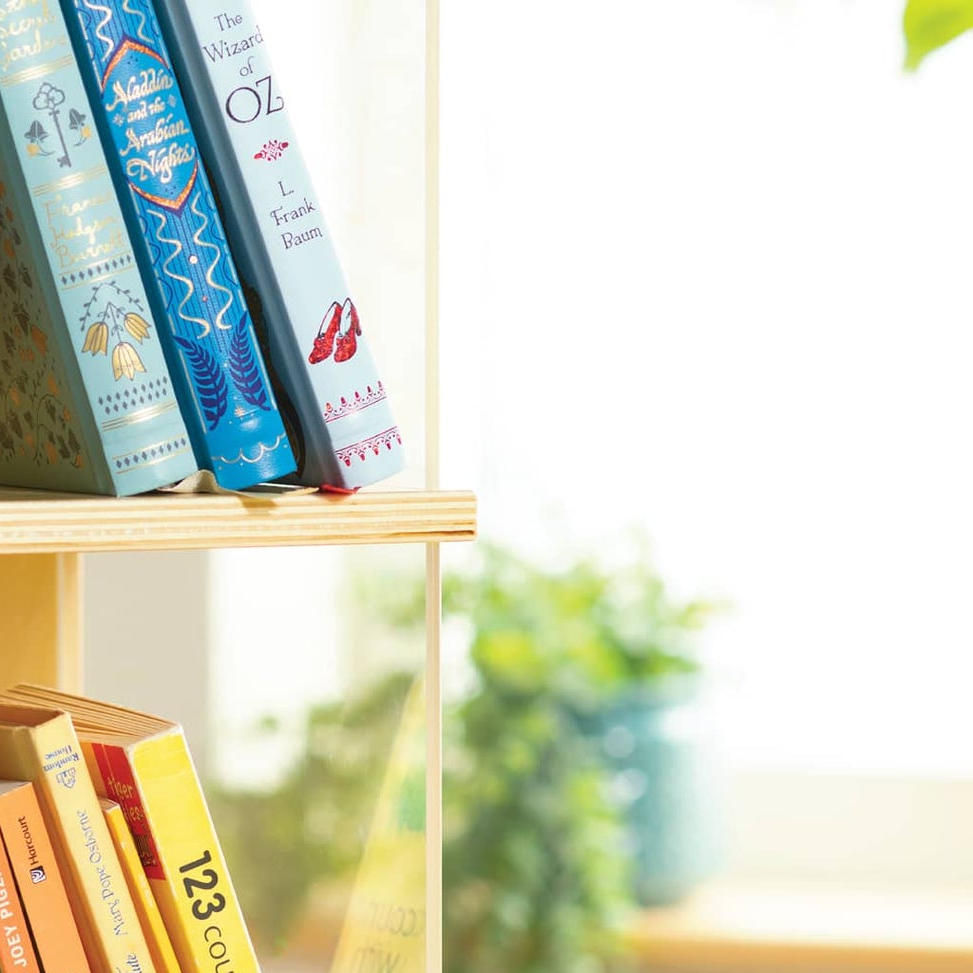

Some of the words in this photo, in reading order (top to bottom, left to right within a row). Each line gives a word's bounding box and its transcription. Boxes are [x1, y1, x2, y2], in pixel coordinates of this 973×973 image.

[214, 12, 243, 32] The
[202, 25, 265, 63] Wizard
[239, 55, 255, 77] of
[105, 68, 174, 112] Aladdin
[128, 107, 148, 123] and
[148, 97, 166, 114] the
[120, 113, 190, 157] Arabian
[126, 142, 196, 184] Nights
[278, 180, 295, 197] L.
[269, 197, 317, 227] Frank
[281, 226, 324, 250] Baum
[43, 752, 80, 772] Random
[45, 745, 72, 760] House
[18, 815, 39, 866] Harcourt
[77, 809, 102, 864] Osborne
[96, 865, 114, 901] Pope
[179, 850, 226, 921] 123
[108, 899, 129, 937] Mary
[4, 925, 27, 967] JOEY
